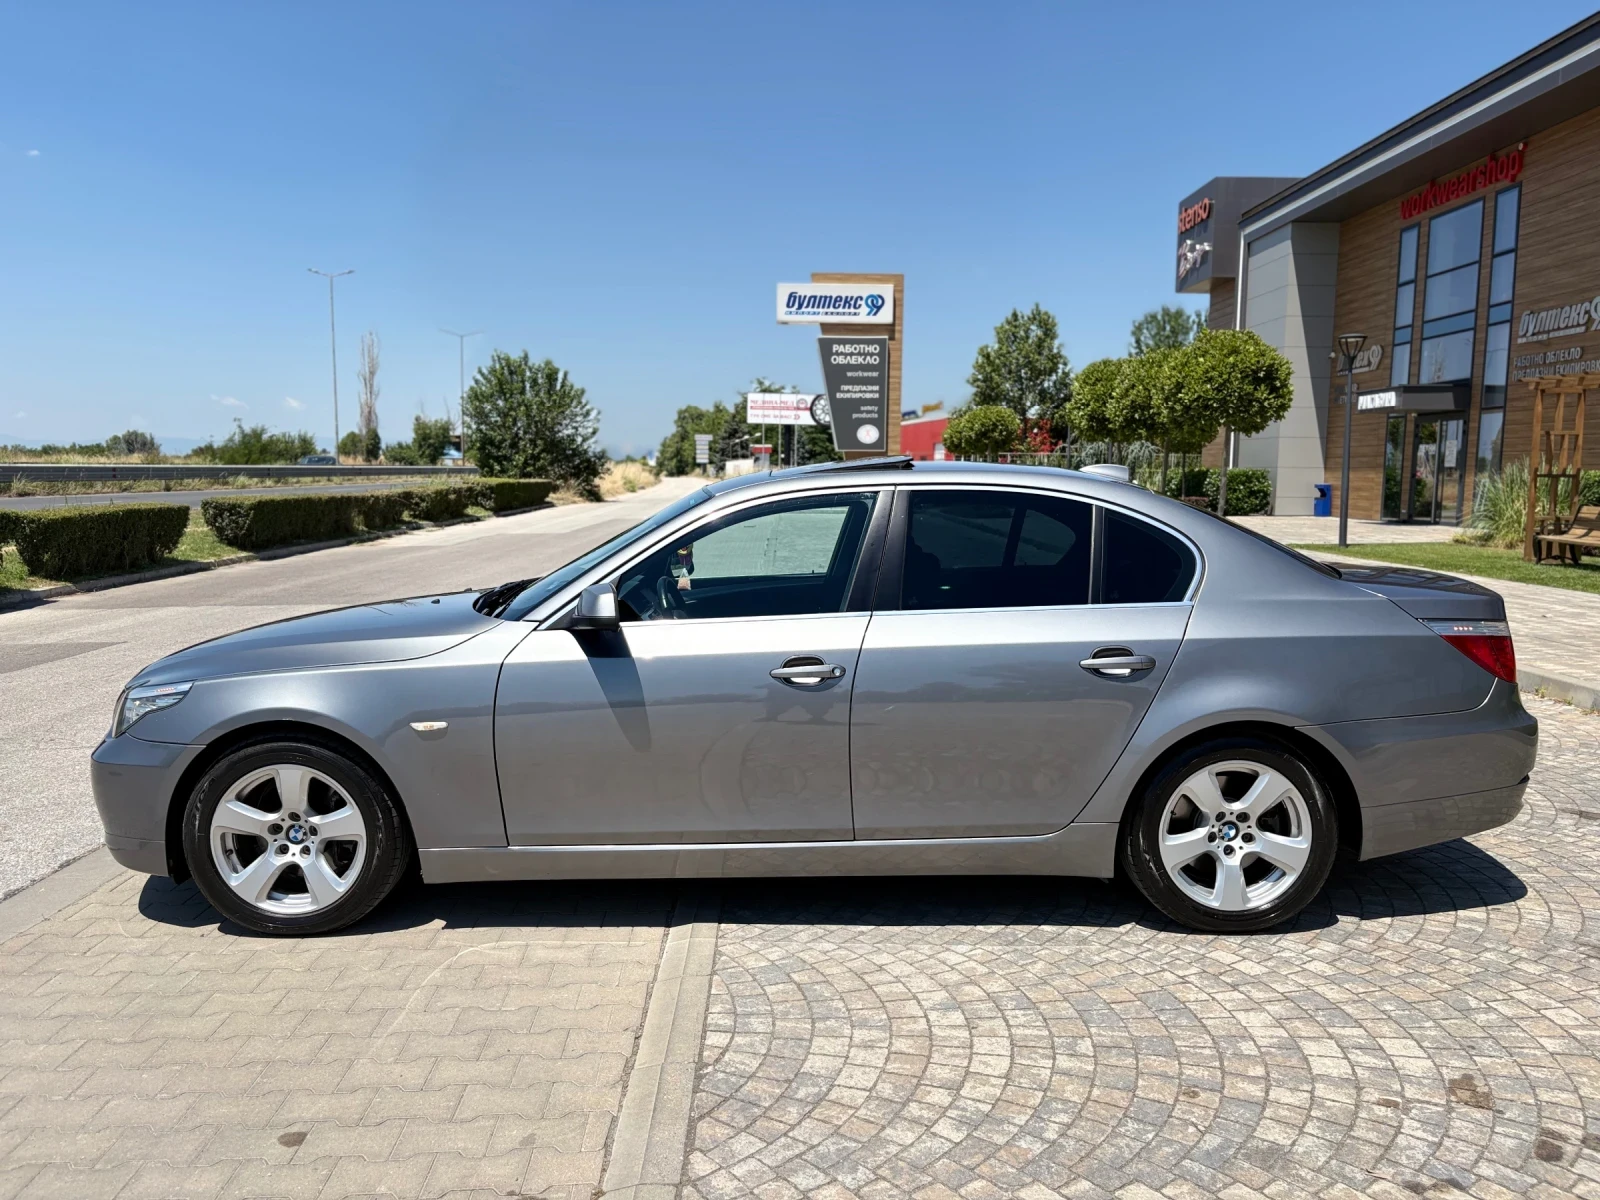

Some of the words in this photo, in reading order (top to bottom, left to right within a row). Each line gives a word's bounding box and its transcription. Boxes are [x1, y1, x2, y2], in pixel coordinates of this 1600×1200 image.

[1400, 150, 1524, 220] workwearshop
[832, 344, 880, 354] РАБОТНО
[831, 355, 880, 365] ОБЛЕКЛО
[1513, 352, 1544, 368] РАБОТНО
[1545, 347, 1582, 364] ОБЛЕКЛО
[1556, 359, 1600, 376] ЕКИПИРОВК
[846, 370, 880, 378] workwear
[852, 412, 879, 420] products
